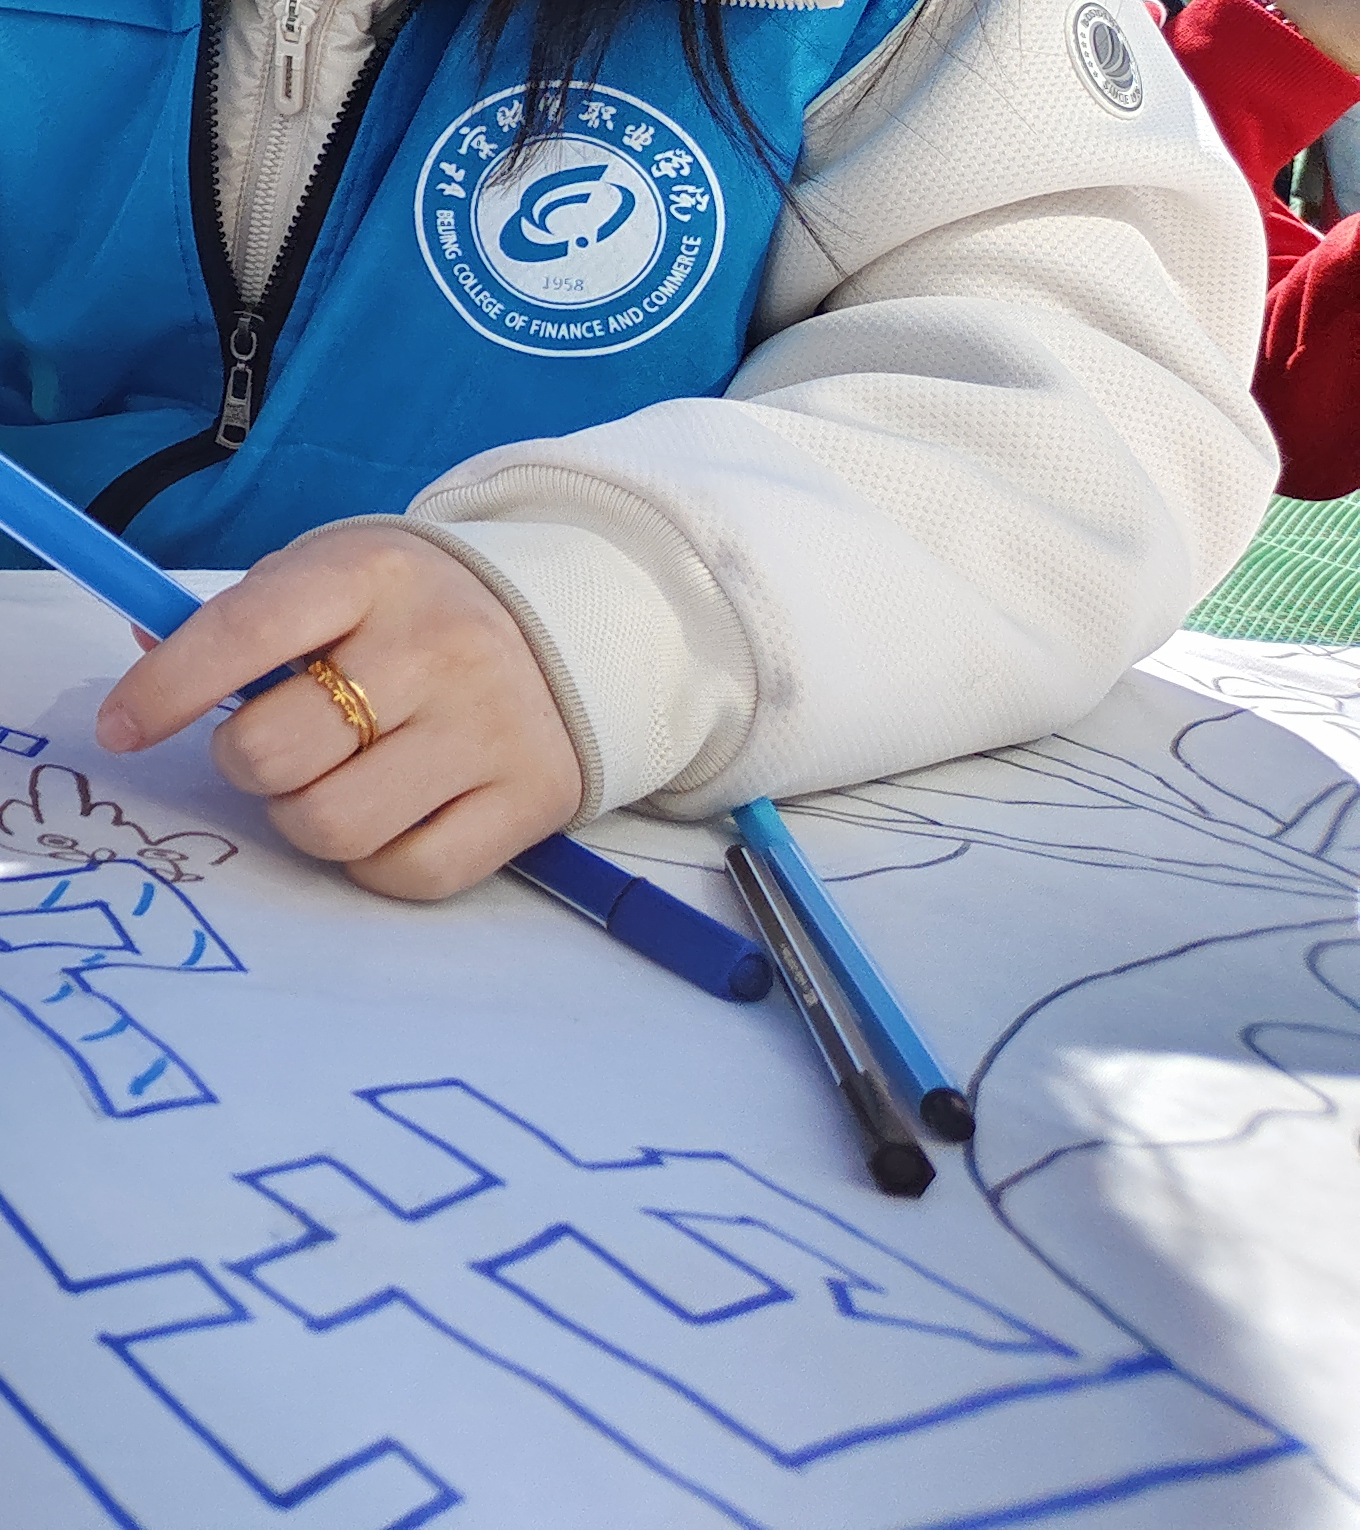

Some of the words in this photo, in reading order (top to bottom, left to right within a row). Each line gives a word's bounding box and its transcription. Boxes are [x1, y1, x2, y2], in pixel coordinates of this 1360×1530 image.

[435, 208, 463, 261] BEIJING
[452, 263, 505, 320] COLLEGE
[505, 310, 530, 329] OF
[529, 319, 606, 341] FINANCE
[608, 306, 645, 335] AND
[642, 235, 702, 314] COMMERCE
[541, 276, 585, 292] 1958
